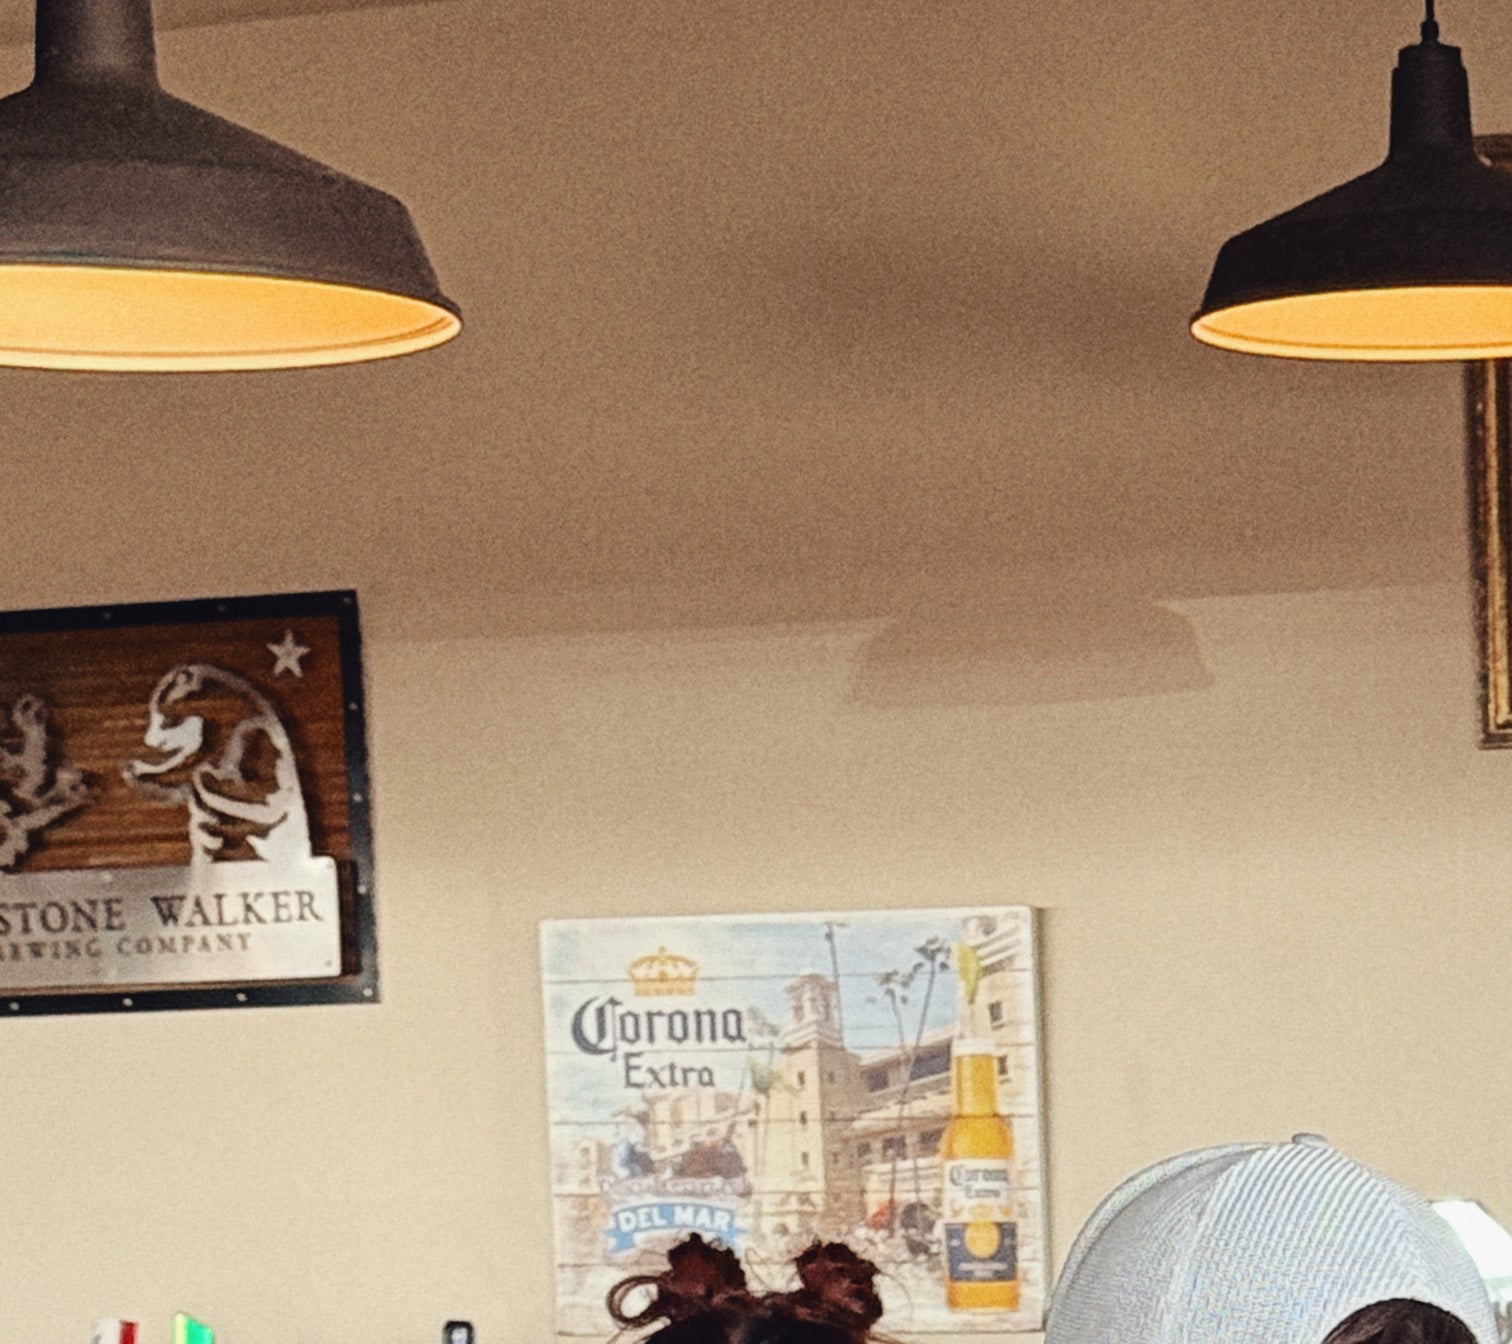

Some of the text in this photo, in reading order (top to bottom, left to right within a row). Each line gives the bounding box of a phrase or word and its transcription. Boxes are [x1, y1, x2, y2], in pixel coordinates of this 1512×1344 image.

[150, 890, 324, 928] WALKER
[0, 932, 252, 962] EWING COMPANY
[570, 995, 748, 1062] Corona
[622, 1051, 715, 1089] Extra
[617, 1205, 732, 1233] DEL MAR
